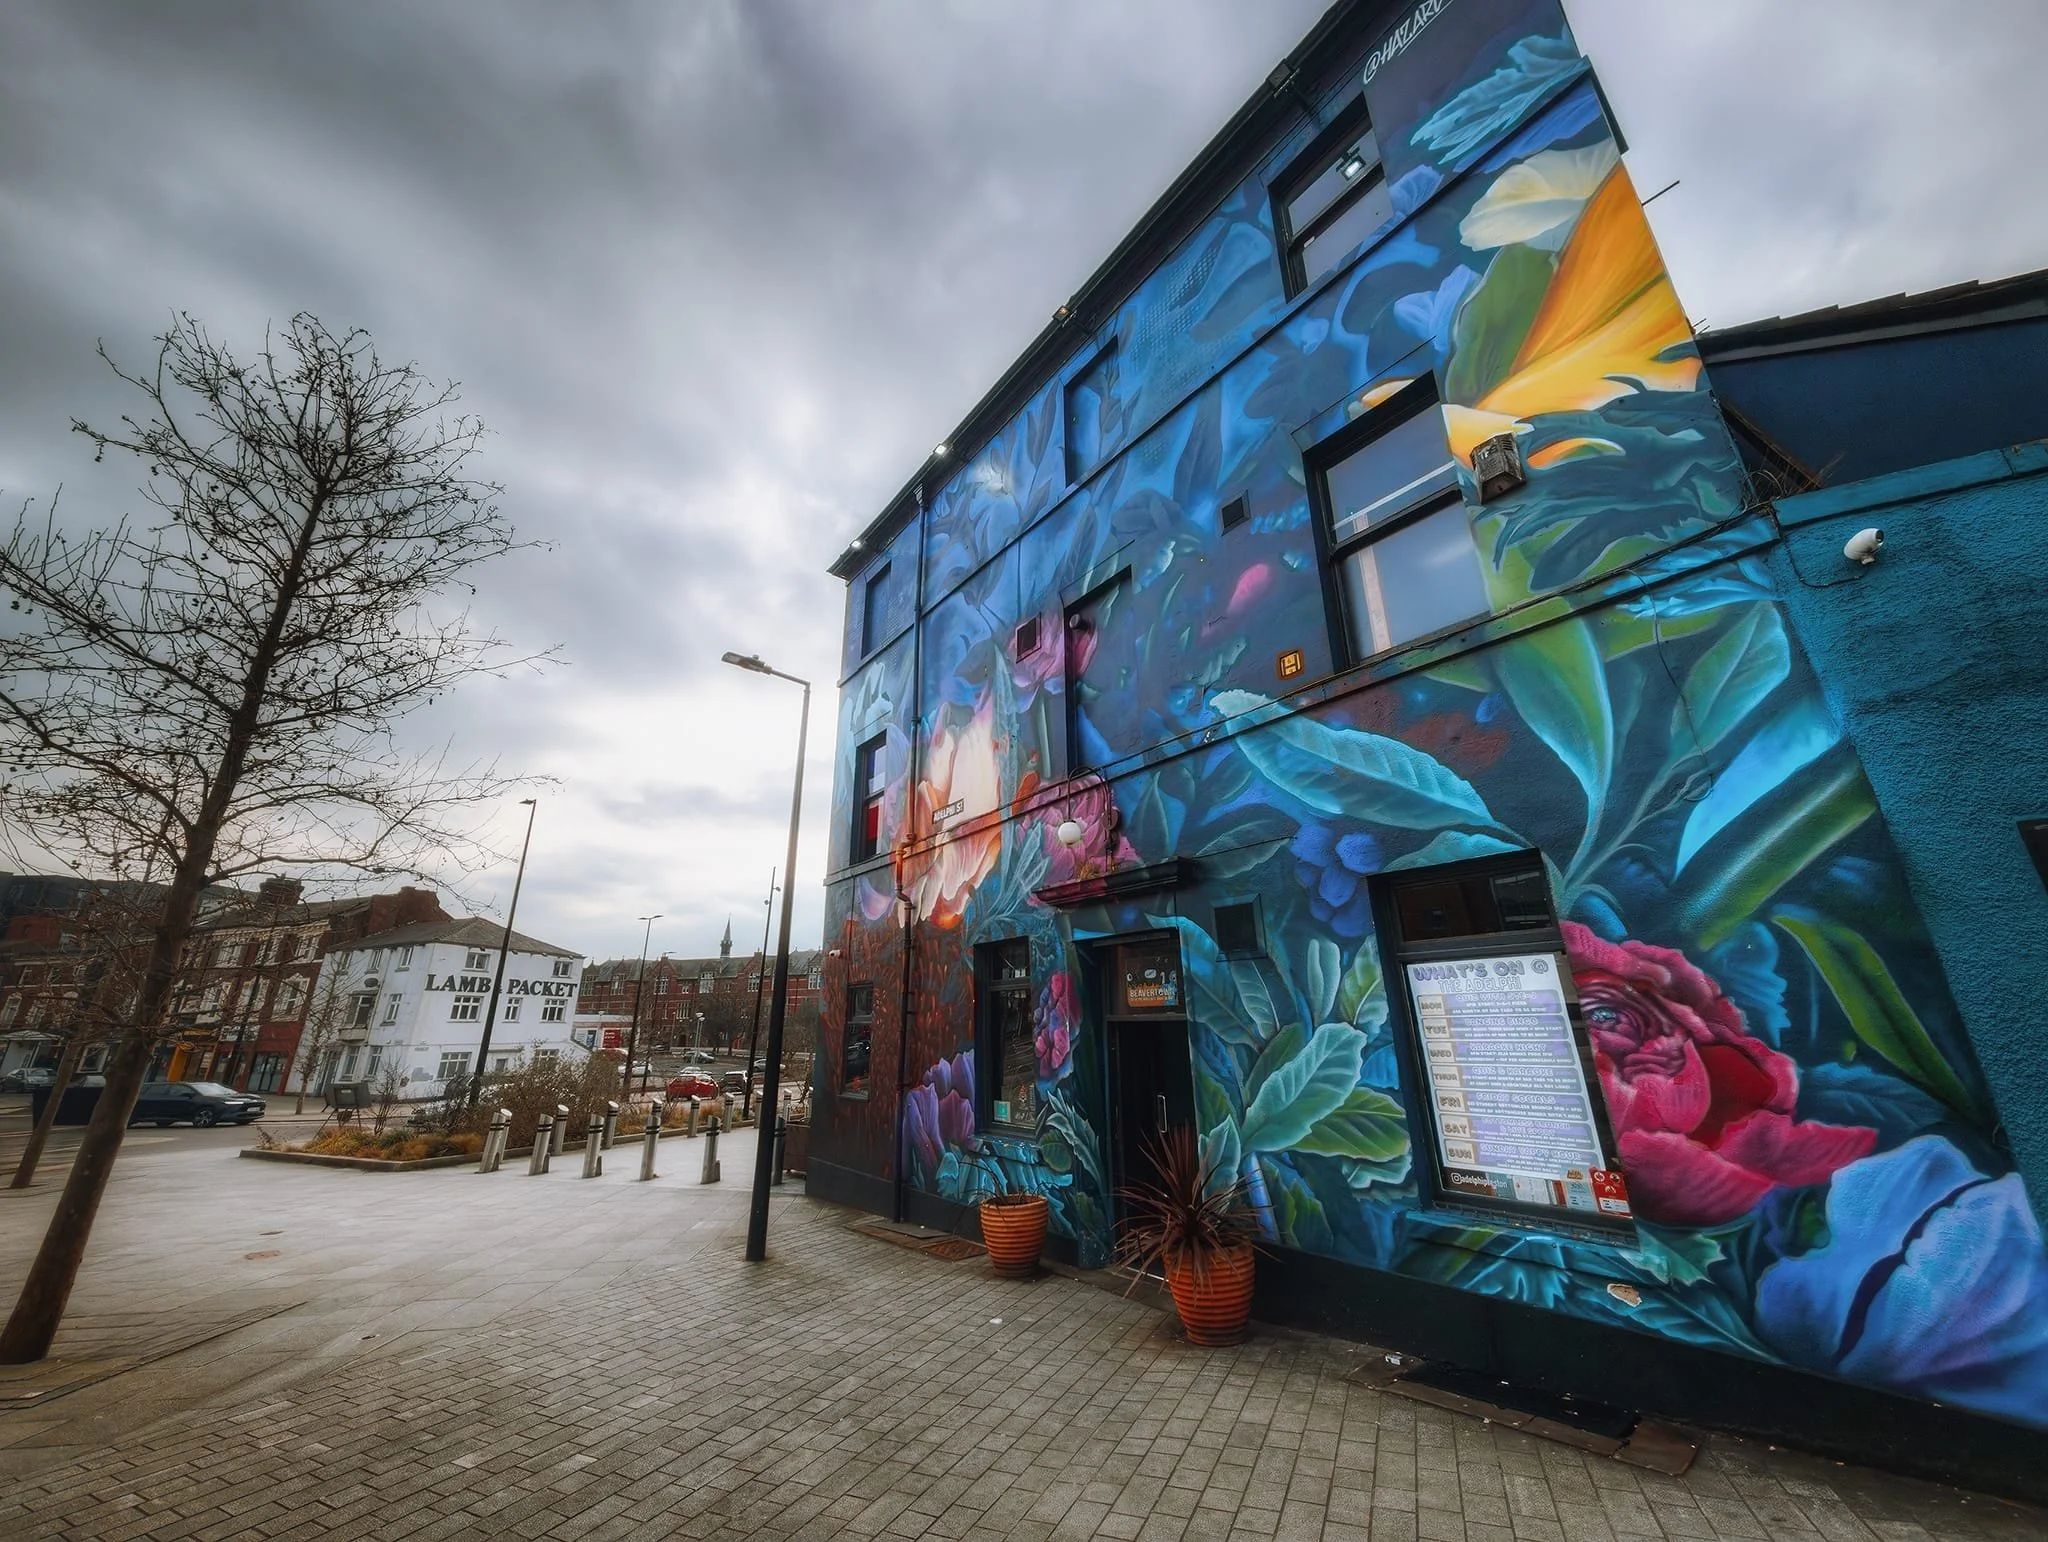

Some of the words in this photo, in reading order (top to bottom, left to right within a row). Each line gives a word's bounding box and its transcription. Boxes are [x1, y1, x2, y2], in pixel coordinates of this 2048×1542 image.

[1413, 963, 1488, 981] WHAT'S
[1493, 959, 1525, 977] ON
[424, 974, 492, 993] LAMB
[506, 979, 578, 997] PACKET
[1438, 979, 1463, 993] THE
[1465, 976, 1522, 992] ADELPHI
[1421, 1002, 1442, 1010] MON
[1425, 1027, 1447, 1035] TUE
[1430, 1050, 1452, 1058] WED
[1433, 1073, 1458, 1081] THUR
[1439, 1095, 1461, 1108] FRI
[1511, 1094, 1556, 1104] SOCIALS
[1444, 1124, 1467, 1135] SAT
[1447, 1148, 1472, 1159] SUN
